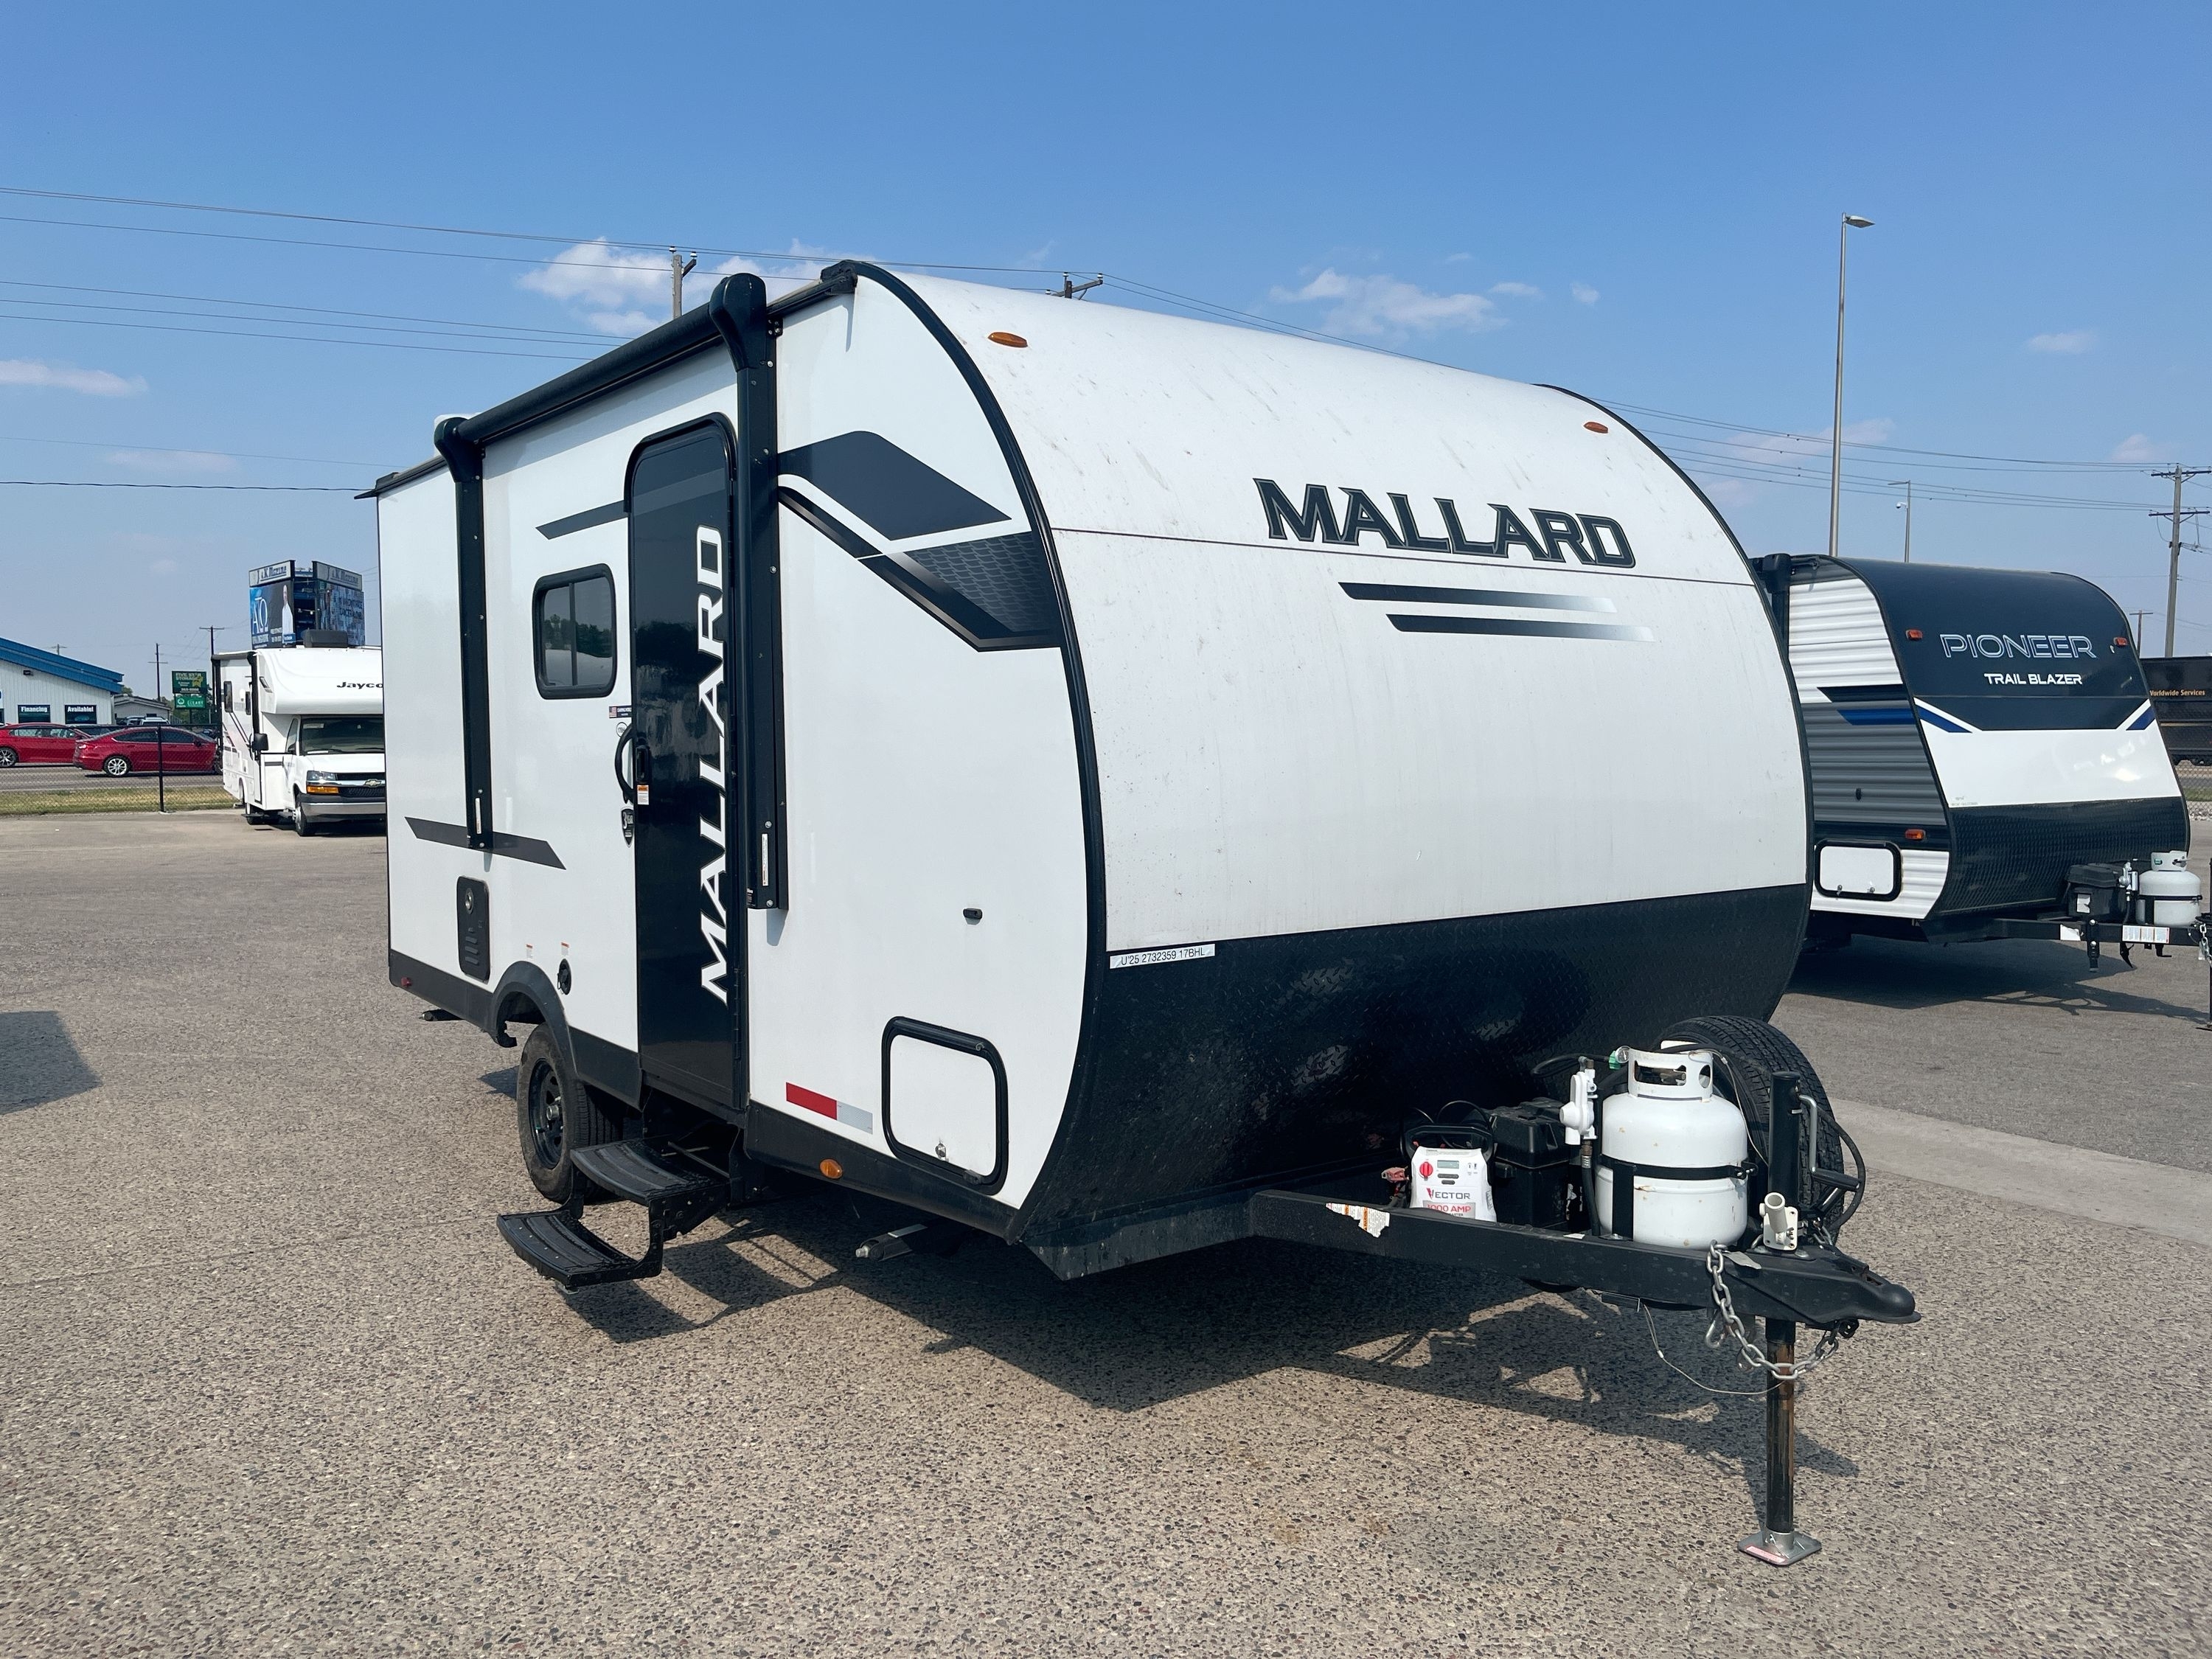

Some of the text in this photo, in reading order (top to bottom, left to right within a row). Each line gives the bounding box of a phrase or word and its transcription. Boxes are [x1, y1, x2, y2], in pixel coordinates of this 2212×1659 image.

[1253, 478, 1636, 568] MALLARD
[1939, 634, 2098, 658] PIONEER
[336, 681, 383, 689] Jayco
[1984, 673, 2083, 685] TRAIL BLAZER
[696, 525, 728, 1007] MALLARD
[1121, 947, 1206, 966] U'25 2732359 17BHL
[1426, 1188, 1471, 1200] VECTOR
